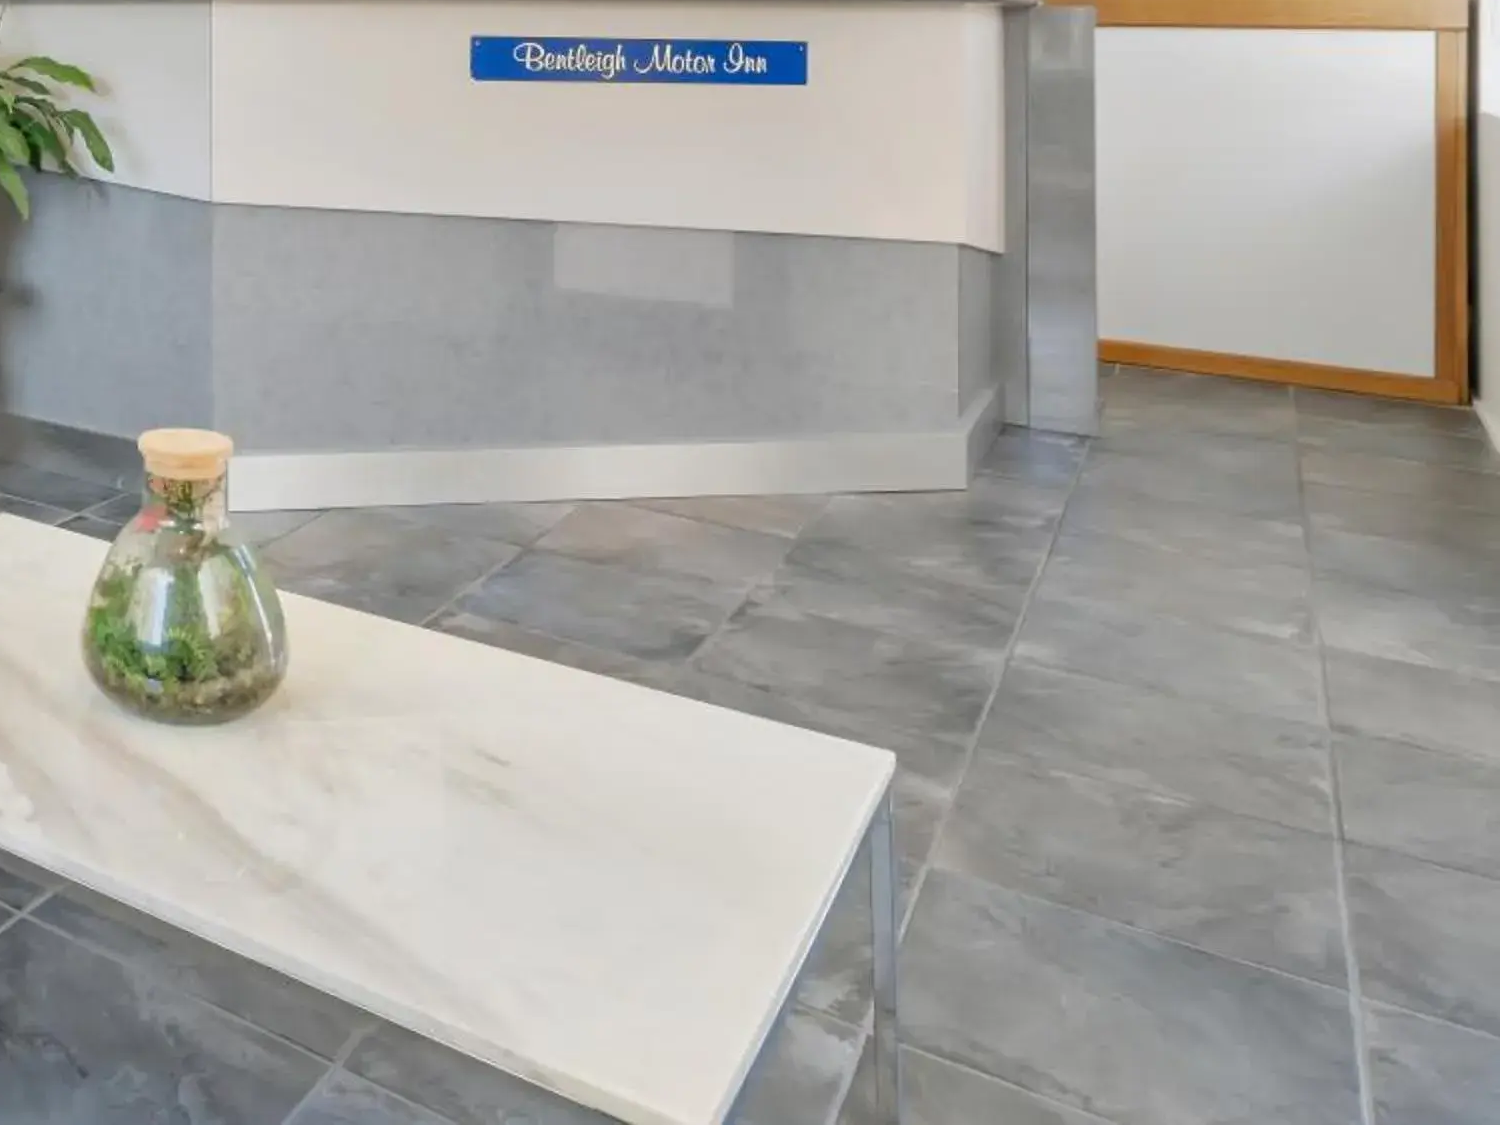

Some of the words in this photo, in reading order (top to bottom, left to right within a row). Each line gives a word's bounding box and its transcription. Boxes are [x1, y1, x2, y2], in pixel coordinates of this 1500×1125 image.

[513, 42, 627, 79] Bentleigh
[634, 43, 716, 75] Motor
[723, 42, 768, 74] Inn
